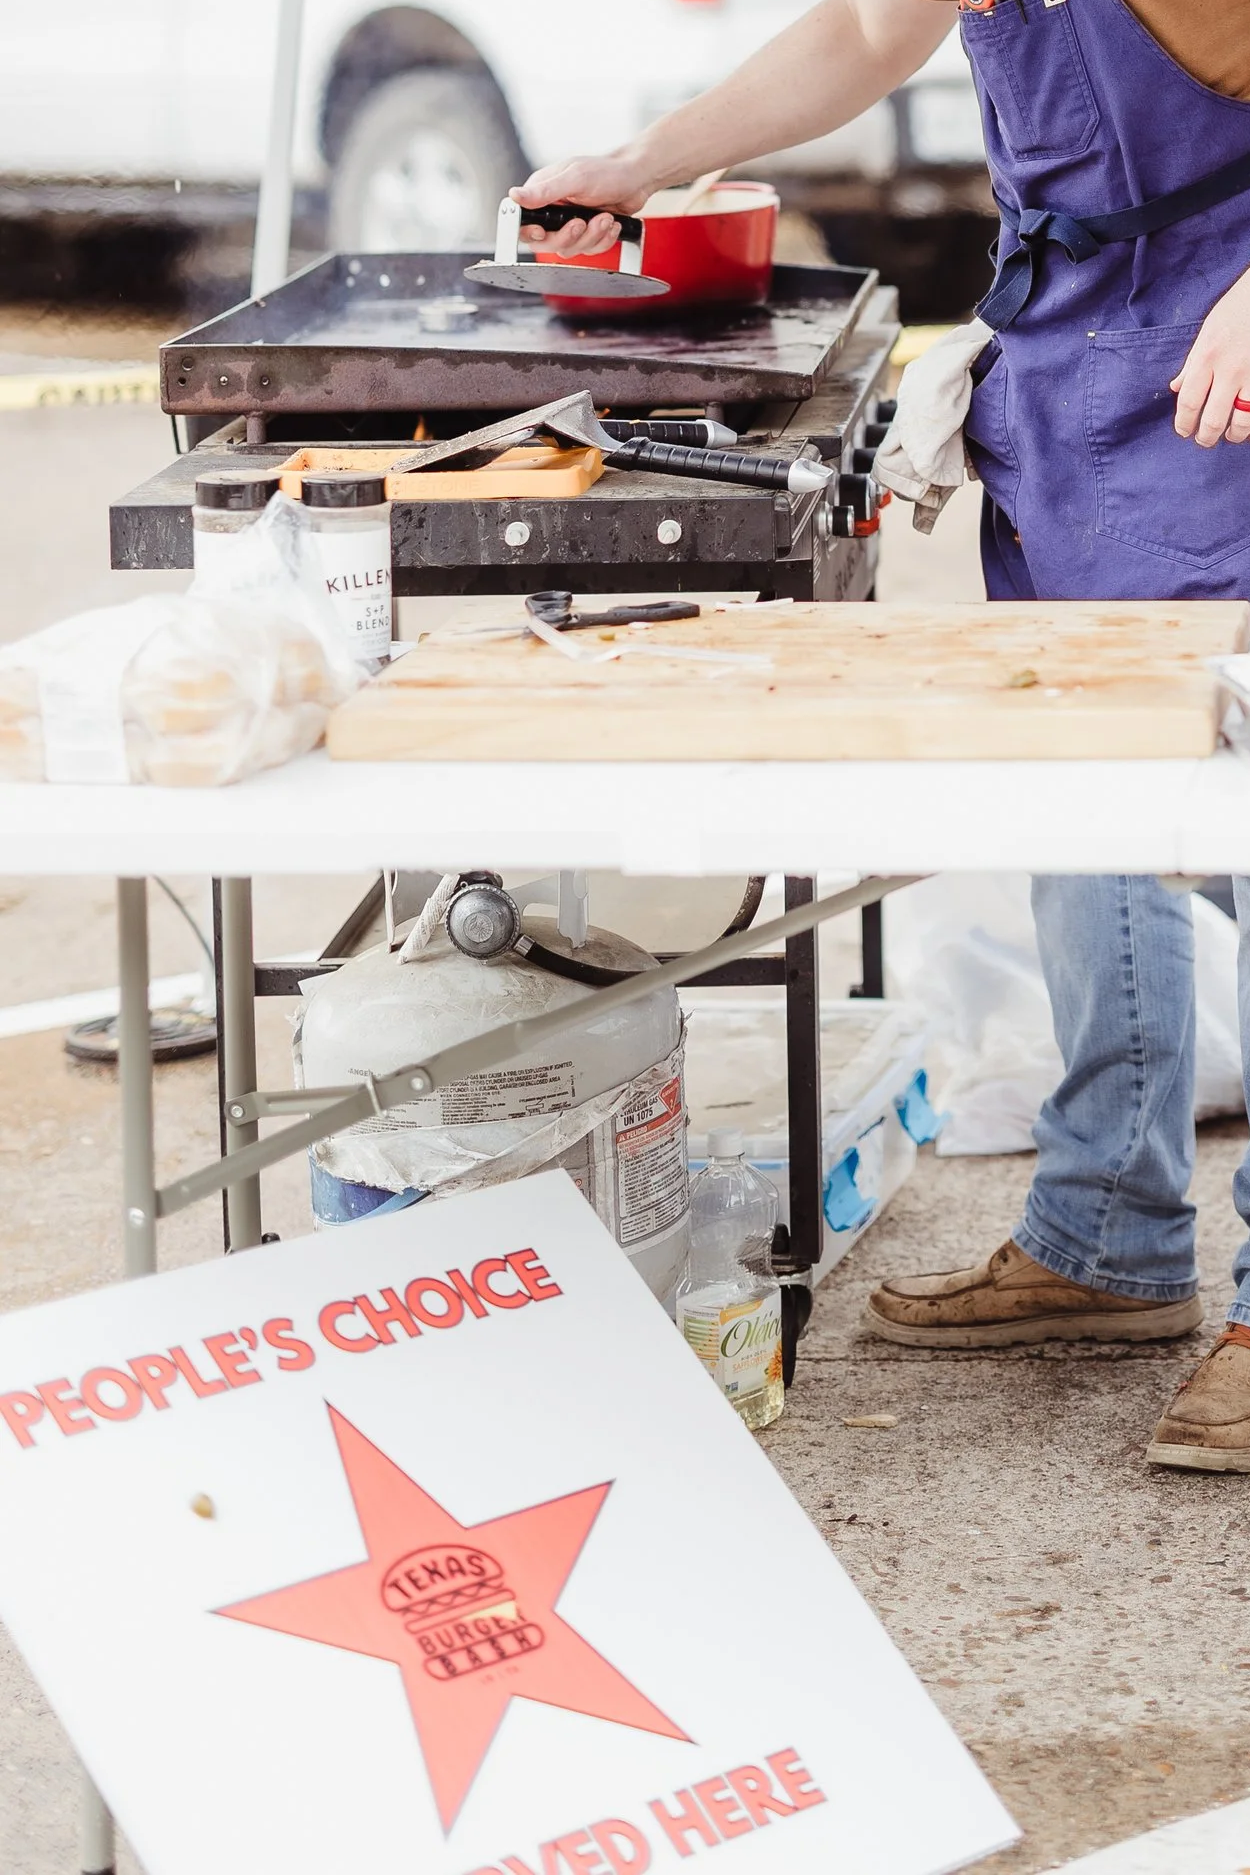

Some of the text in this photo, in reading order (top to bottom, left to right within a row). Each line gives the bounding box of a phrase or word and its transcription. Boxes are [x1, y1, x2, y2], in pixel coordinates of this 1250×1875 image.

[356, 616, 389, 631] BLEND
[623, 1107, 654, 1126] UN 1075
[648, 1095, 658, 1106] GAS
[0, 1317, 316, 1449] PEOPLE'S
[318, 1247, 564, 1353] CHOICE
[388, 1554, 487, 1601] TEXAS
[439, 1626, 533, 1677] BASH
[647, 1746, 828, 1858] HERE
